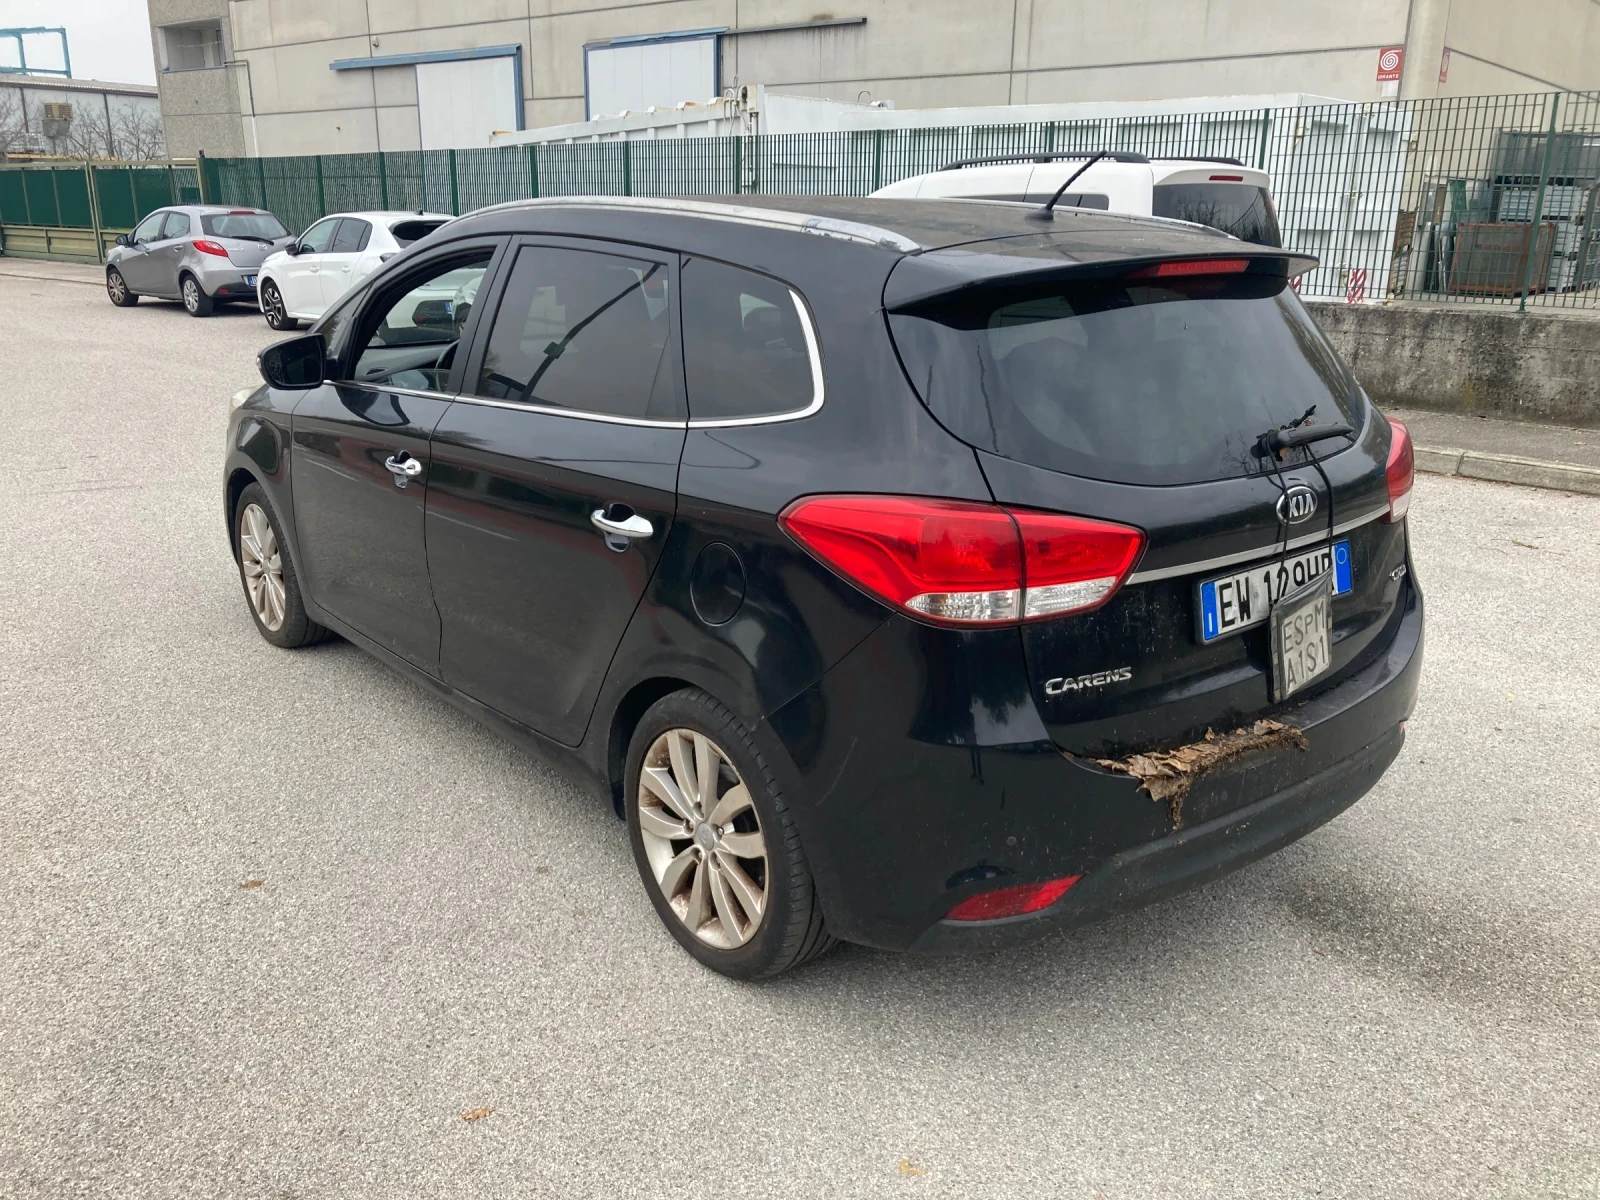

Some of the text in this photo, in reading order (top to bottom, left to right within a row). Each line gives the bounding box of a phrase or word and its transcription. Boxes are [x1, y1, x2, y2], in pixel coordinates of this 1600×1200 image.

[1288, 493, 1314, 518] KIA
[1218, 577, 1251, 628] EW
[1283, 600, 1325, 654] ESPM
[1045, 666, 1132, 695] CARENS
